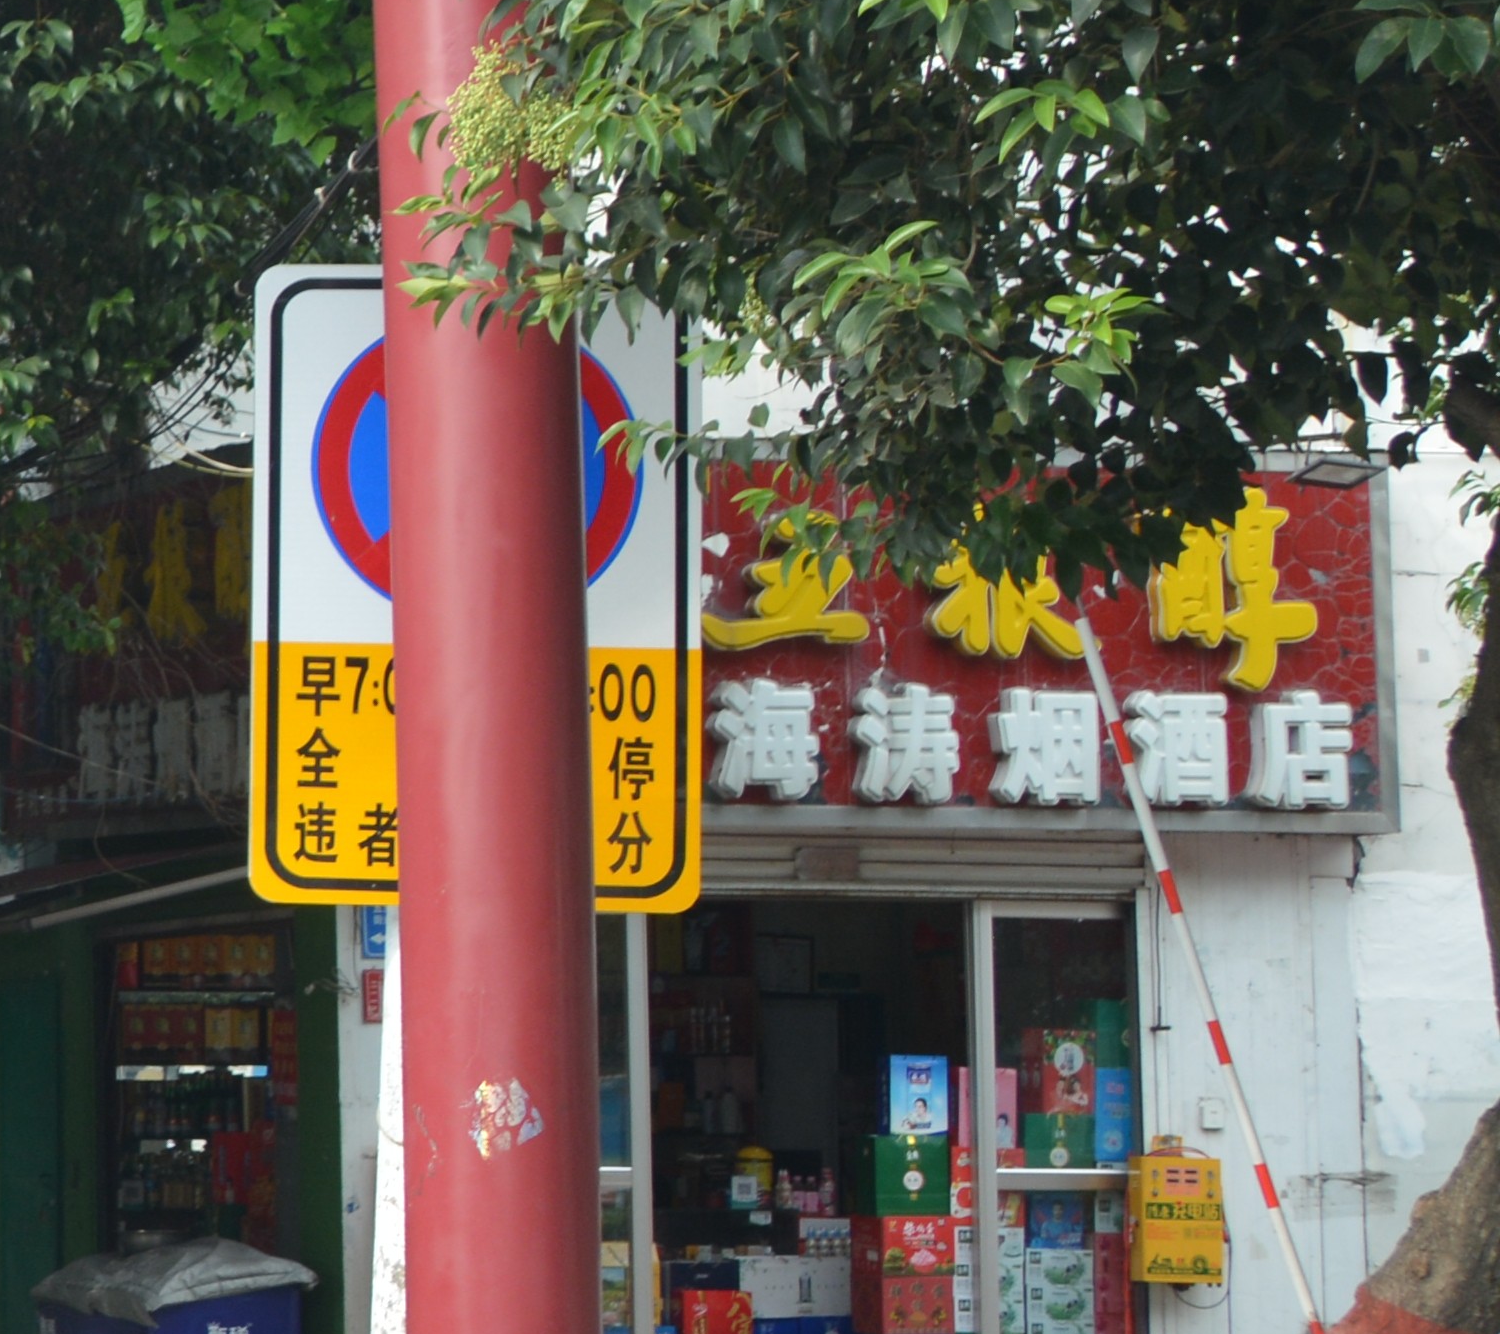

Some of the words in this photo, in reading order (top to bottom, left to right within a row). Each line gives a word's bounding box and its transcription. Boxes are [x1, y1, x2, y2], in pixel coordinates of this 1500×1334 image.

[706, 677, 1353, 811] 海涛烟酒店
